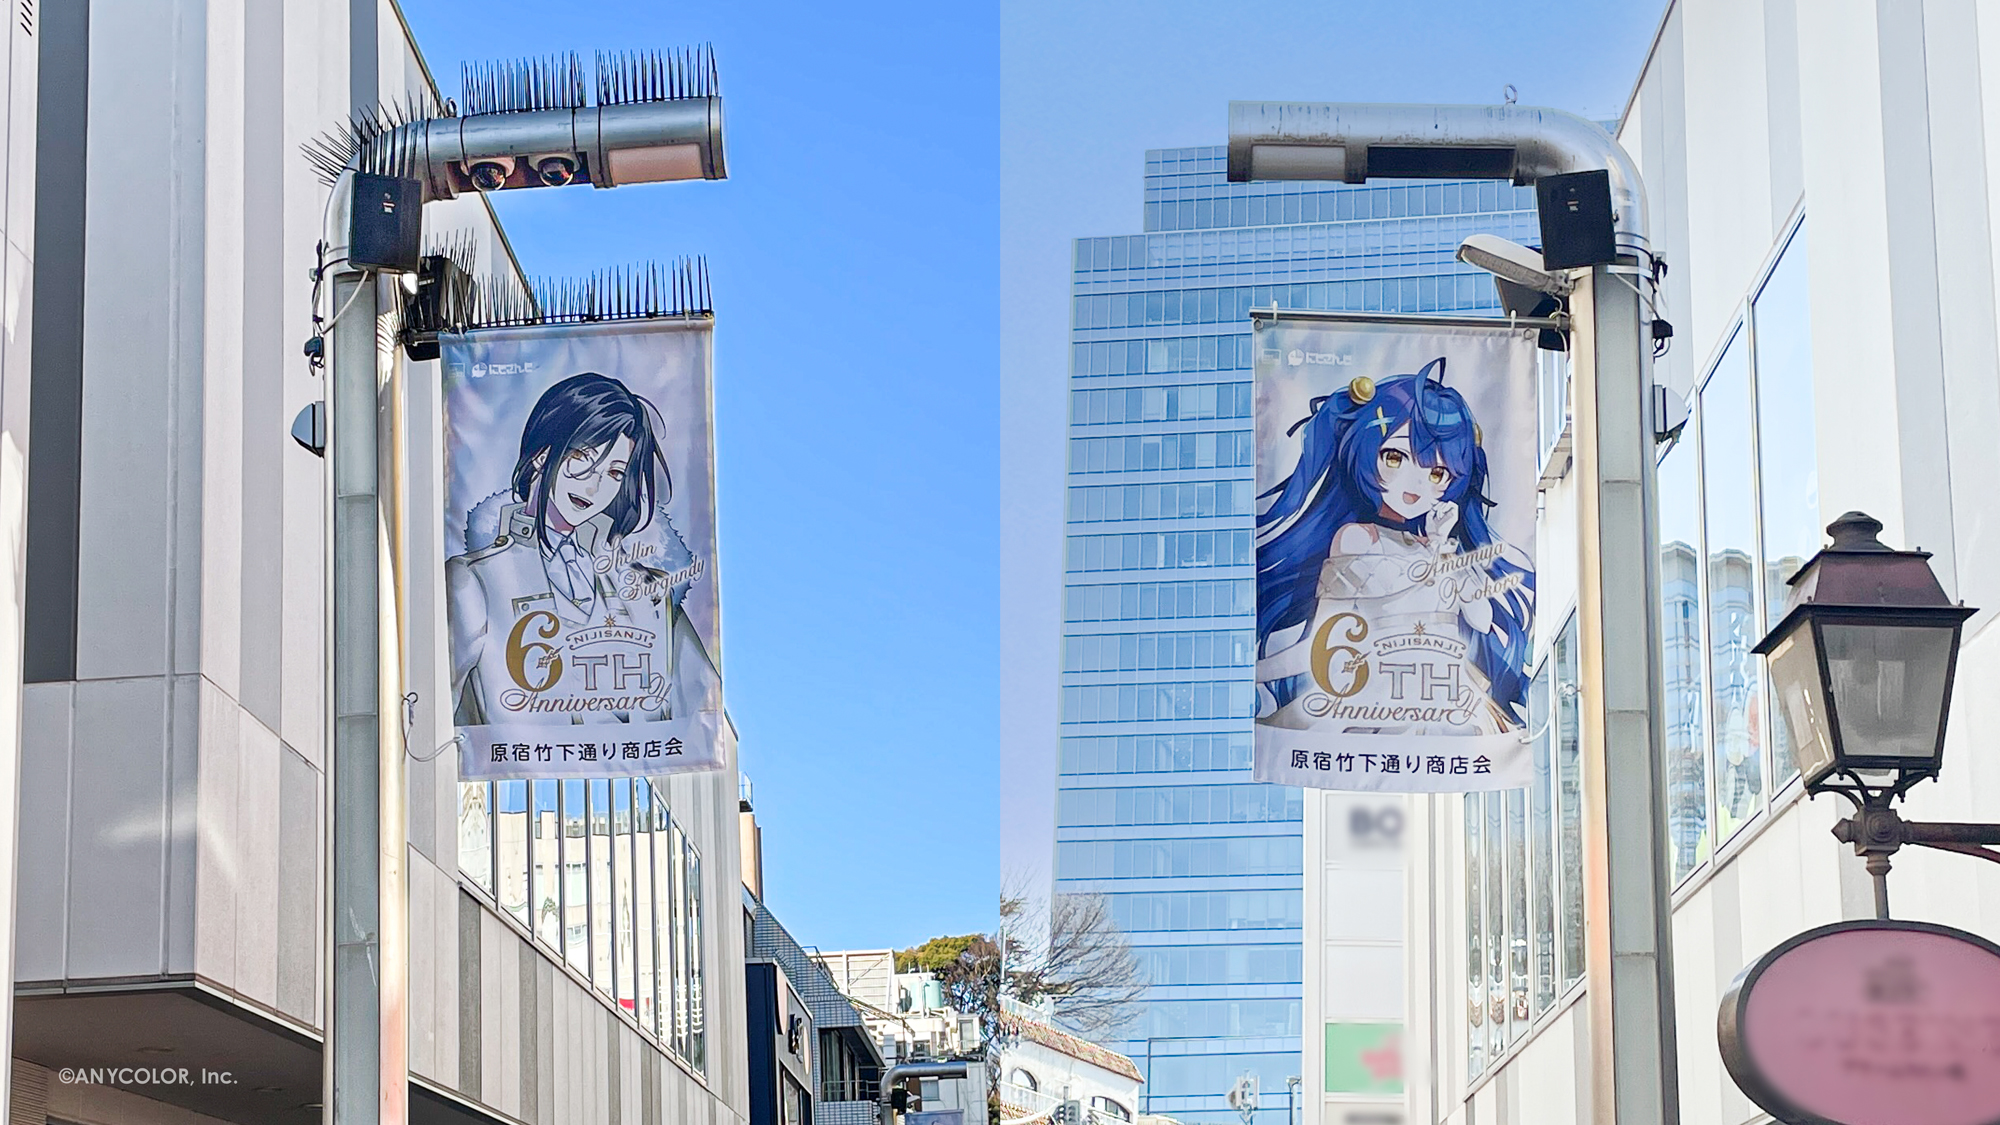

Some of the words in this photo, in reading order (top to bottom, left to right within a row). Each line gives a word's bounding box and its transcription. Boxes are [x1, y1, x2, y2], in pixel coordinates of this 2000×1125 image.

[593, 536, 656, 574] Shellin
[1407, 543, 1505, 582] Amamiya
[618, 554, 705, 601] Burgundy
[1439, 575, 1520, 610] Kokoro
[574, 629, 650, 644] NIJISANJI
[1382, 638, 1458, 653] NIJISANJI
[500, 675, 672, 713] Anniversary
[1302, 684, 1482, 725] Anniversary
[490, 737, 684, 763] 原宿竹下通り商店会
[1291, 749, 1492, 775] 原宿竹下通り商店会
